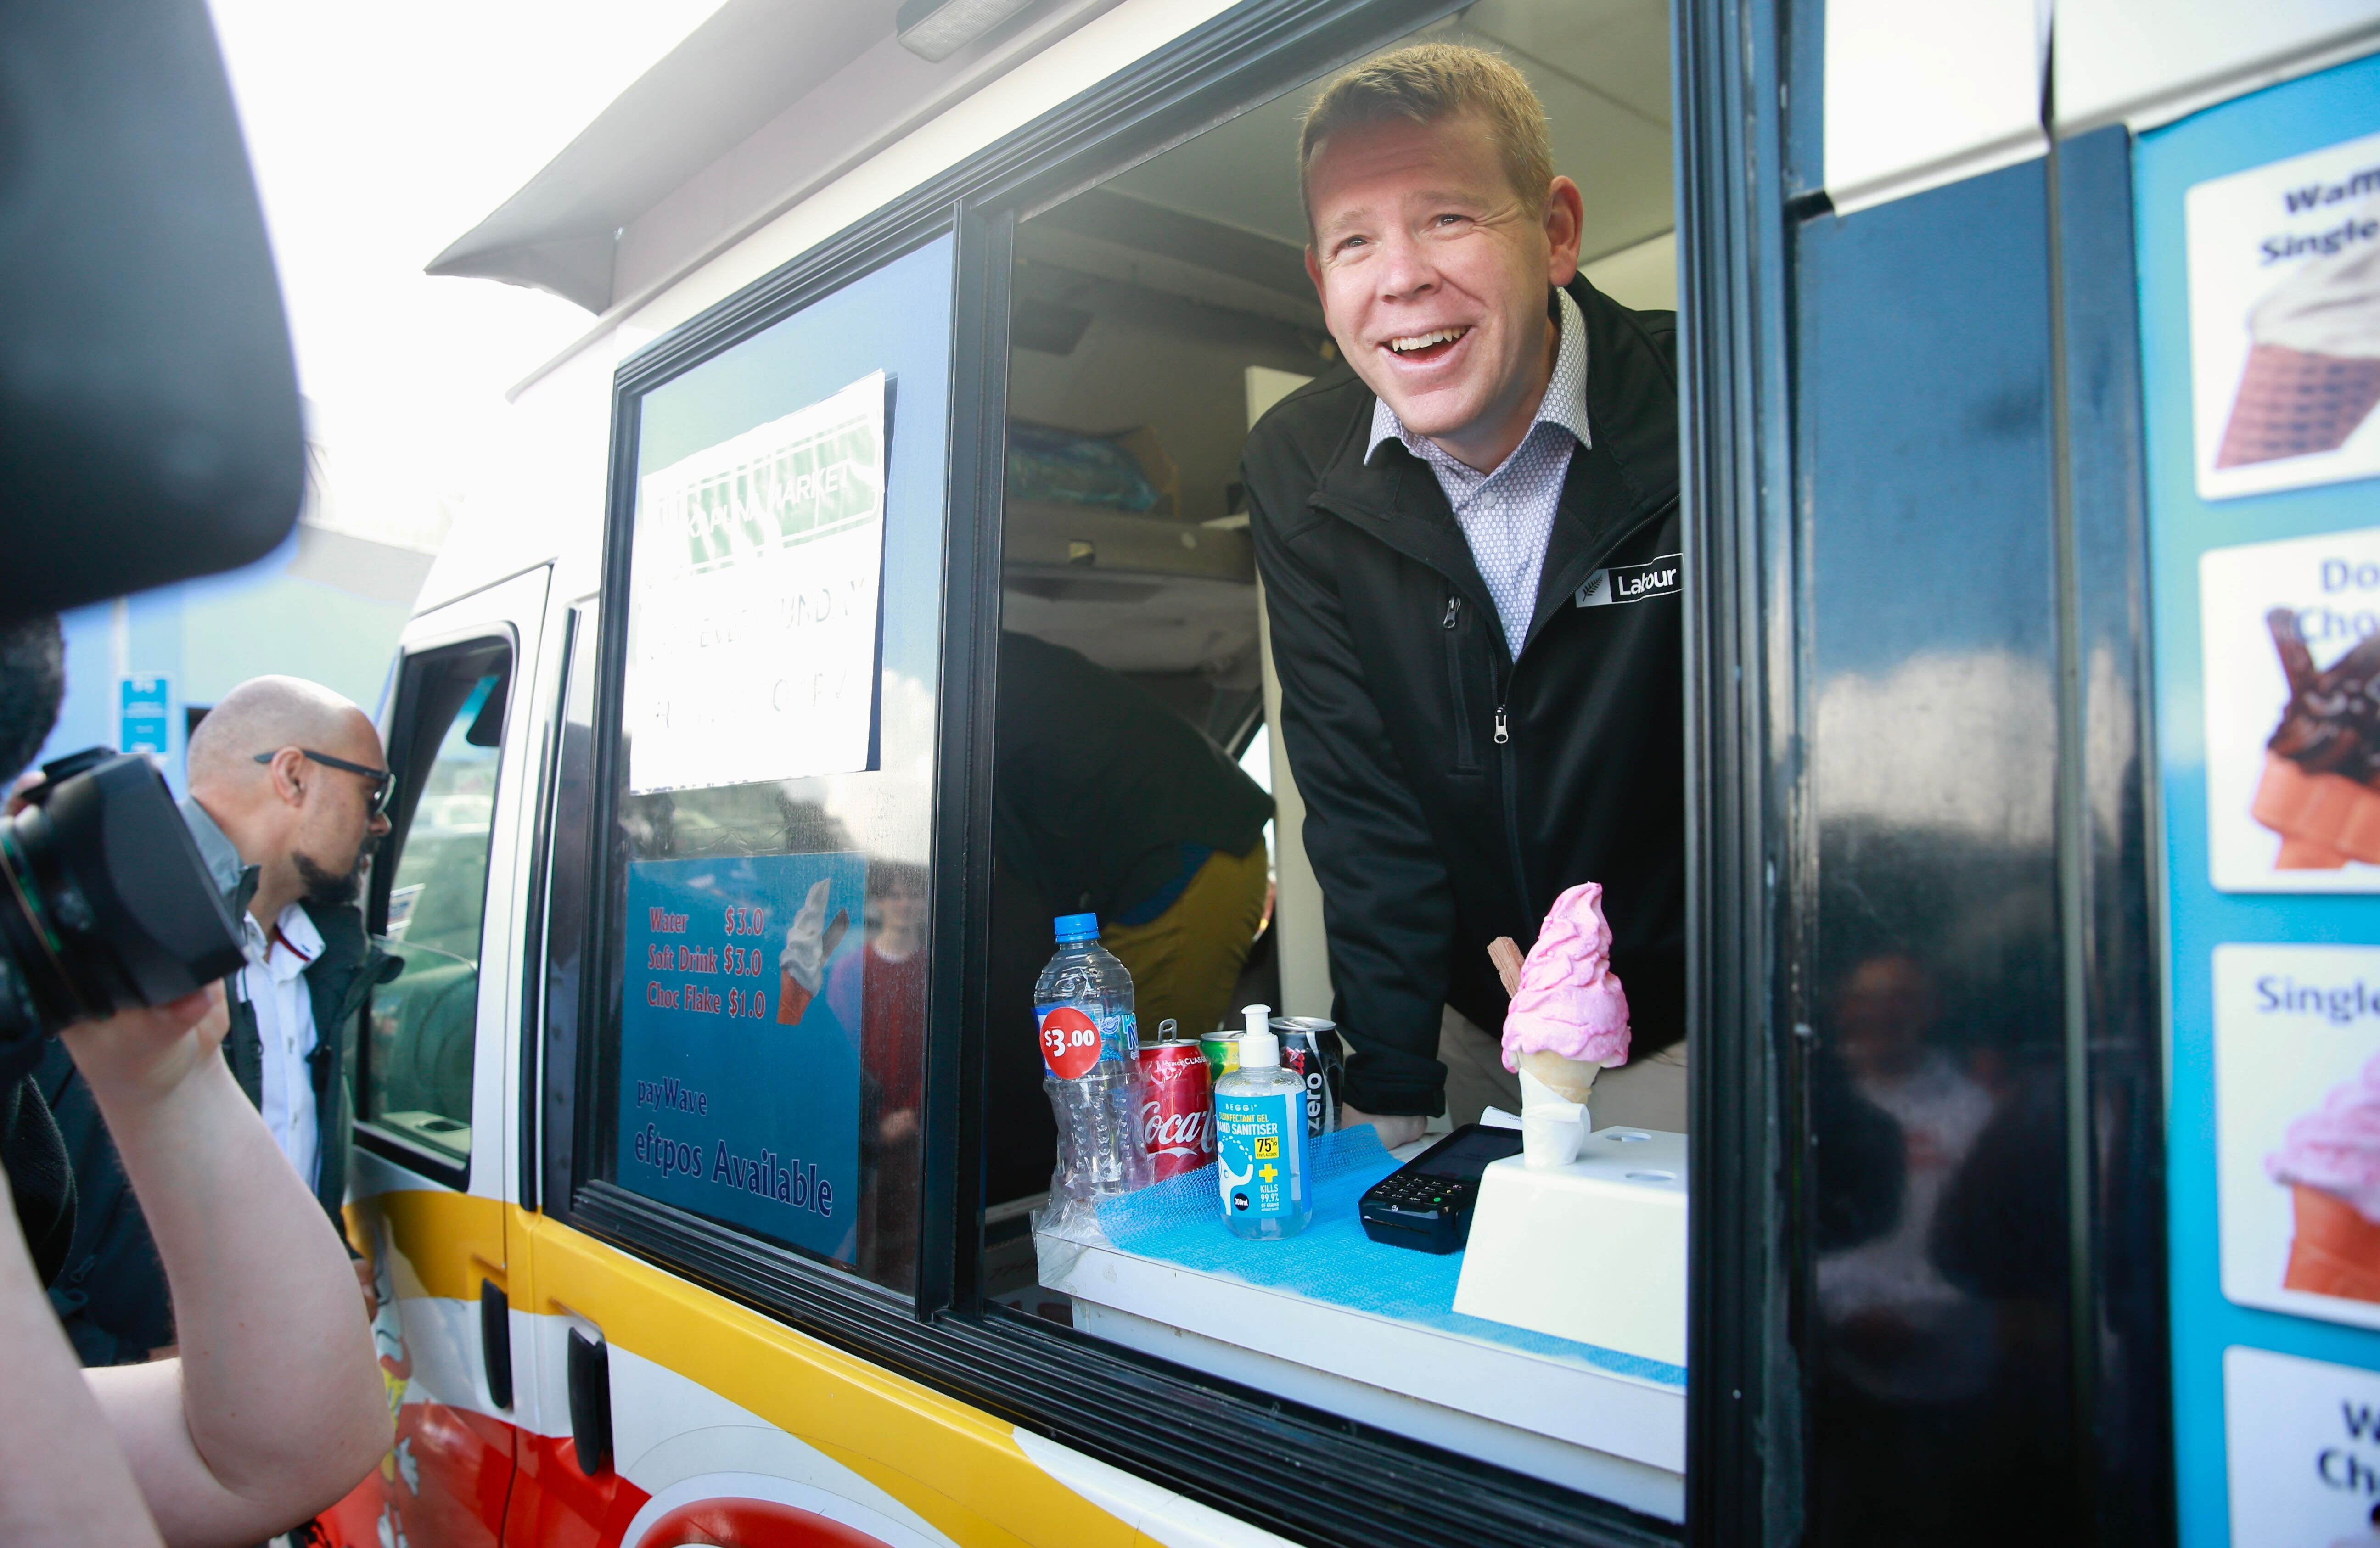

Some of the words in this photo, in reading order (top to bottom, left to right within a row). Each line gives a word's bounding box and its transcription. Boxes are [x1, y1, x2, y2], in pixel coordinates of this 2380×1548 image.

[2262, 220, 2379, 267] Single
[1618, 568, 1677, 595] Labour
[649, 906, 689, 933] Water
[725, 905, 764, 936] $3.0
[648, 943, 674, 970] Soft
[679, 945, 718, 974] Drink
[724, 943, 762, 977] $3.0
[647, 980, 679, 1010] Choc
[684, 984, 721, 1015] Flake
[729, 987, 766, 1019] $1.0
[1044, 1029, 1095, 1057] $3.00
[636, 1076, 707, 1116] payWave
[1307, 1072, 1322, 1131] zero
[1219, 1111, 1255, 1122] DISINFECTANT
[1257, 1114, 1269, 1122] GEL
[1231, 1123, 1278, 1135] SANITISER
[1257, 1138, 1277, 1152] 75%
[634, 1123, 703, 1178] eftpos
[711, 1139, 833, 1217] Available
[1235, 1198, 1248, 1206] 300ml
[1260, 1184, 1279, 1193] KILLS
[1260, 1193, 1280, 1202] 99.9%
